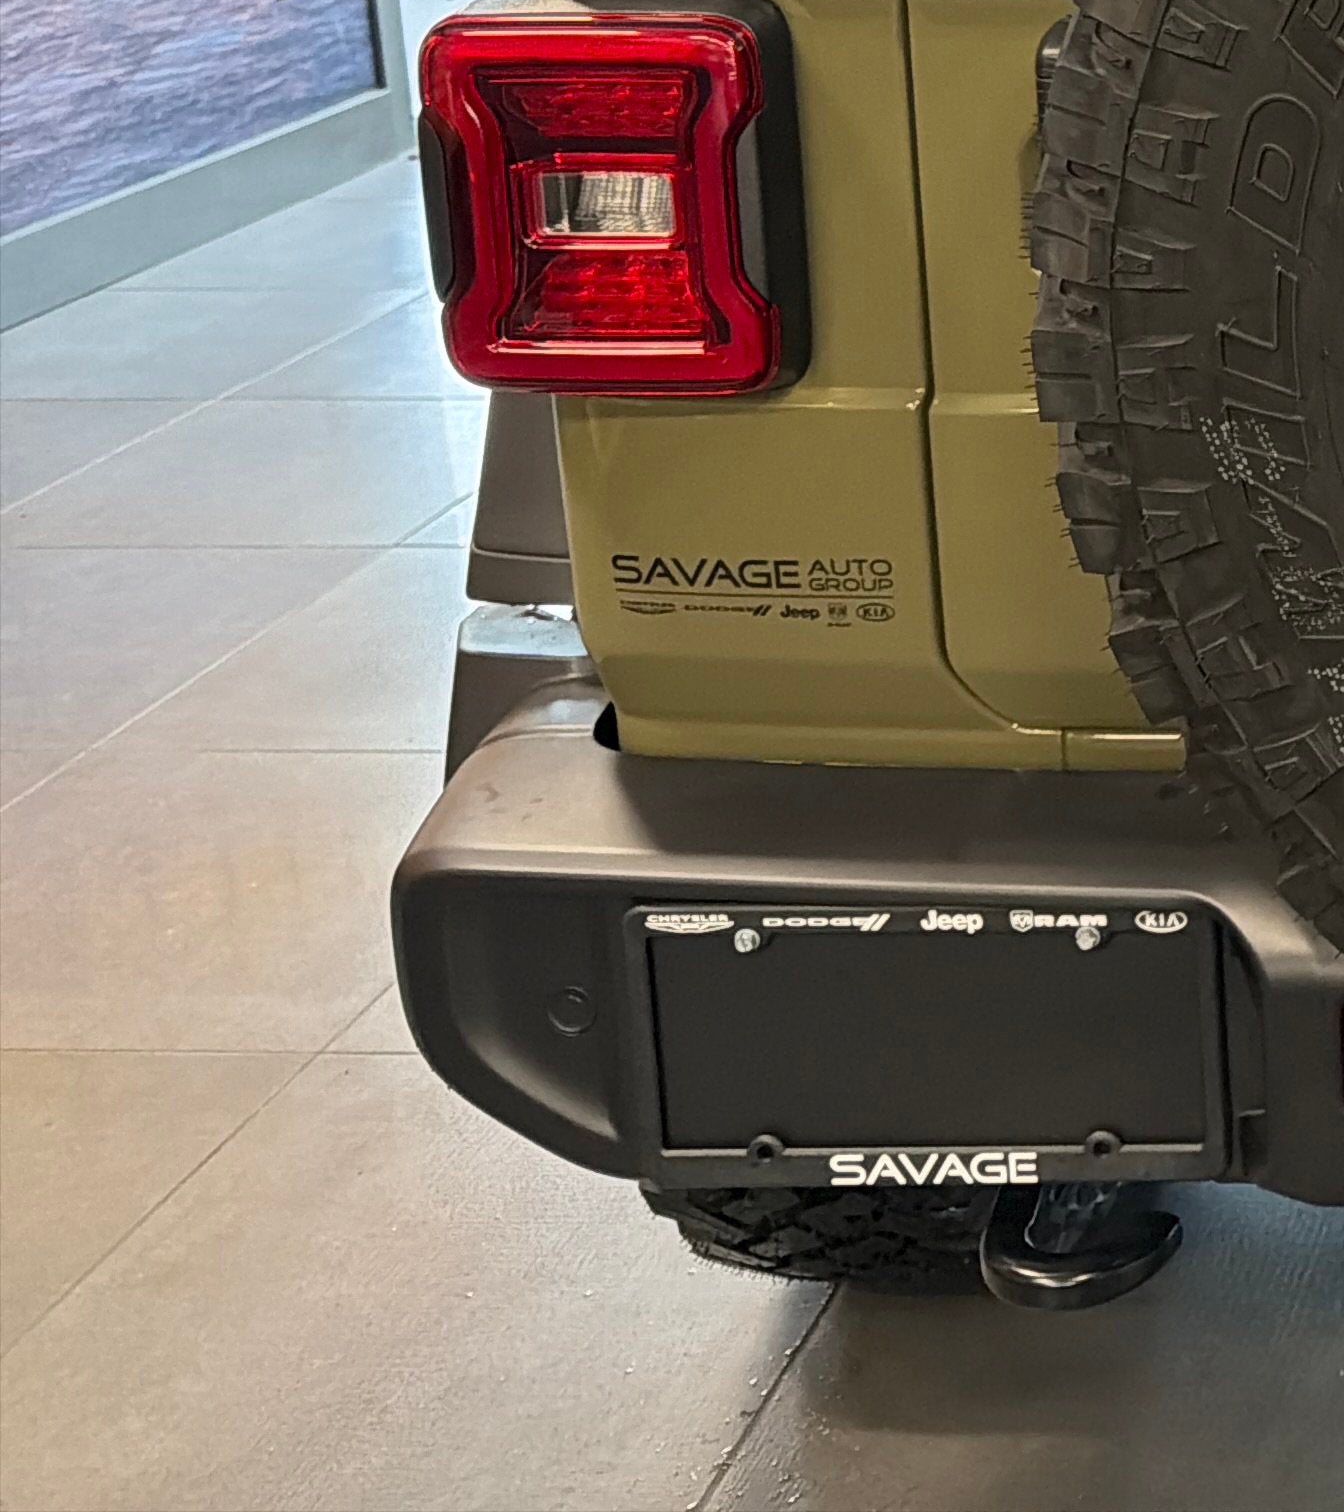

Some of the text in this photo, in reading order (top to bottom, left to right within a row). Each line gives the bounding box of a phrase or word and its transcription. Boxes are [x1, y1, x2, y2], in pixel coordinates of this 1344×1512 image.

[611, 554, 802, 589] SAVAGE
[807, 558, 894, 577] AUTO
[808, 577, 895, 592] GROUP
[779, 604, 820, 621] Jeep
[646, 913, 729, 923] CHRYSLER
[762, 916, 868, 928] DODGE
[920, 909, 984, 935] Jeep
[1034, 914, 1108, 928] RAM
[829, 1151, 1039, 1187] SAVAGE
